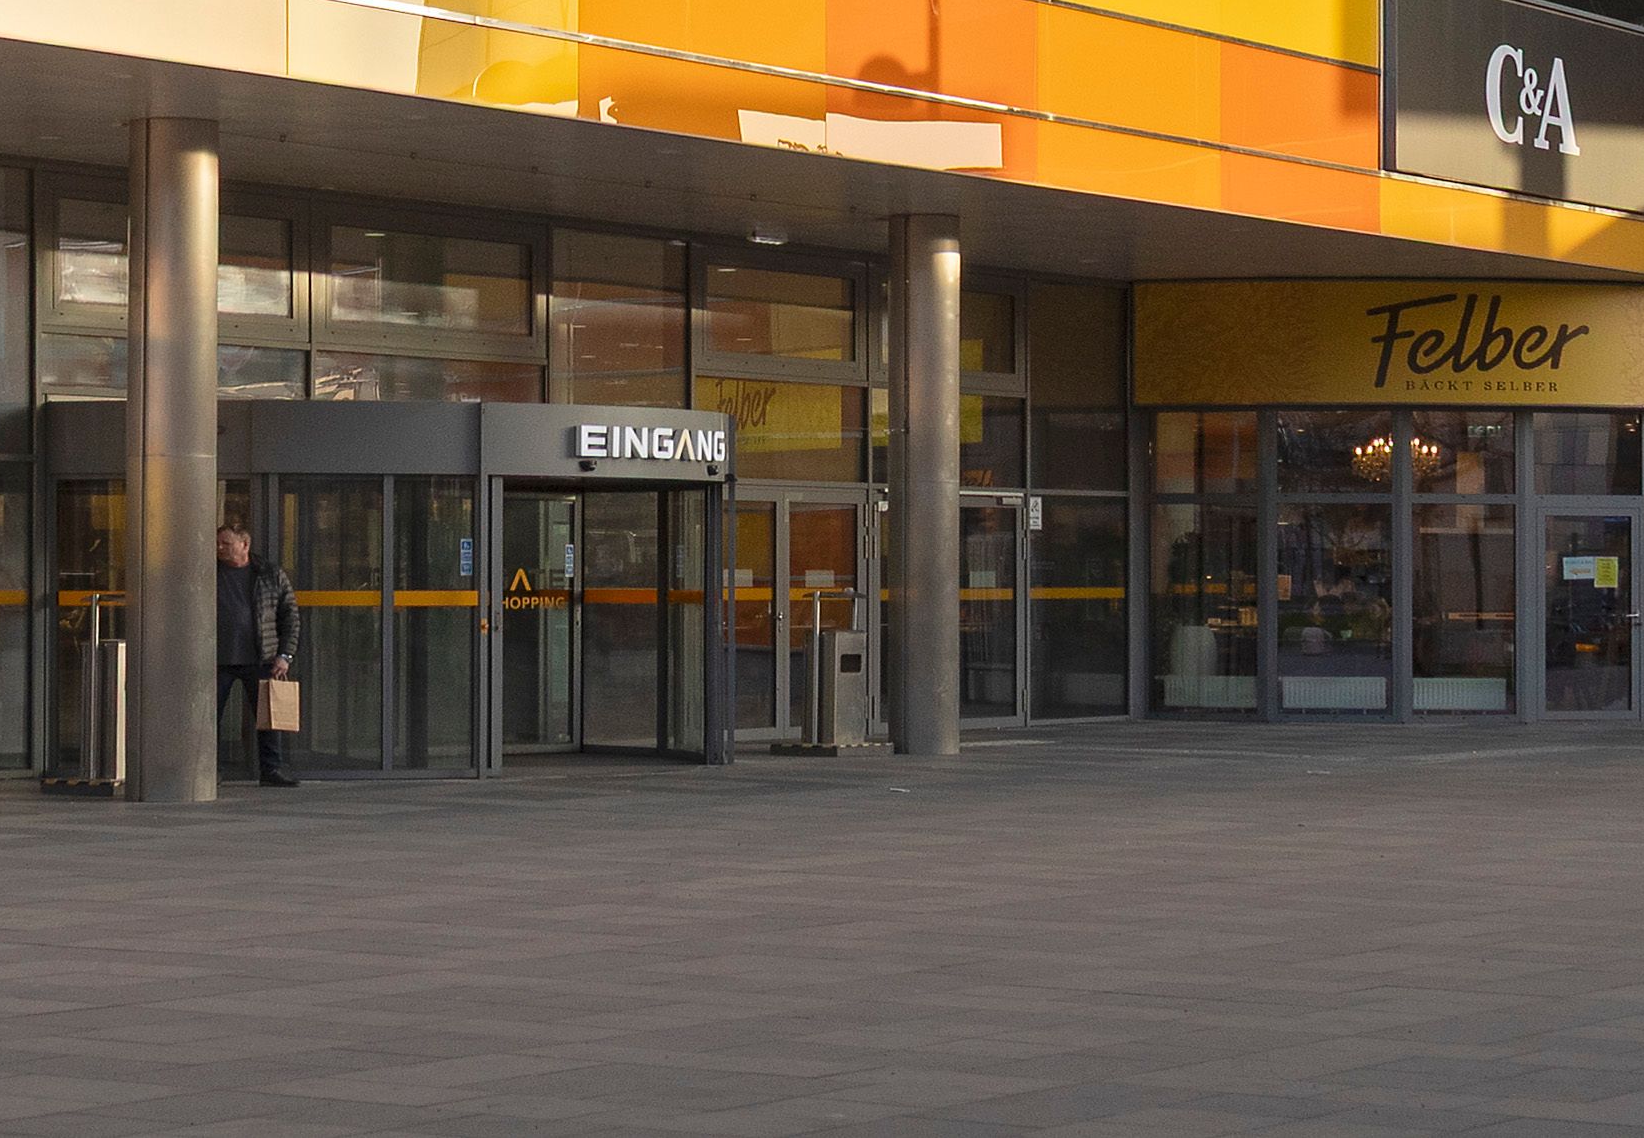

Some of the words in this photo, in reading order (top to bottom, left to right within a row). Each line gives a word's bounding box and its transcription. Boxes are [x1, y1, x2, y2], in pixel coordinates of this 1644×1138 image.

[1486, 44, 1580, 156] C&A
[1366, 293, 1589, 388] Felber
[1483, 380, 1558, 392] SELBER
[577, 424, 726, 462] EINGANG
[501, 596, 565, 609] HOPPING
